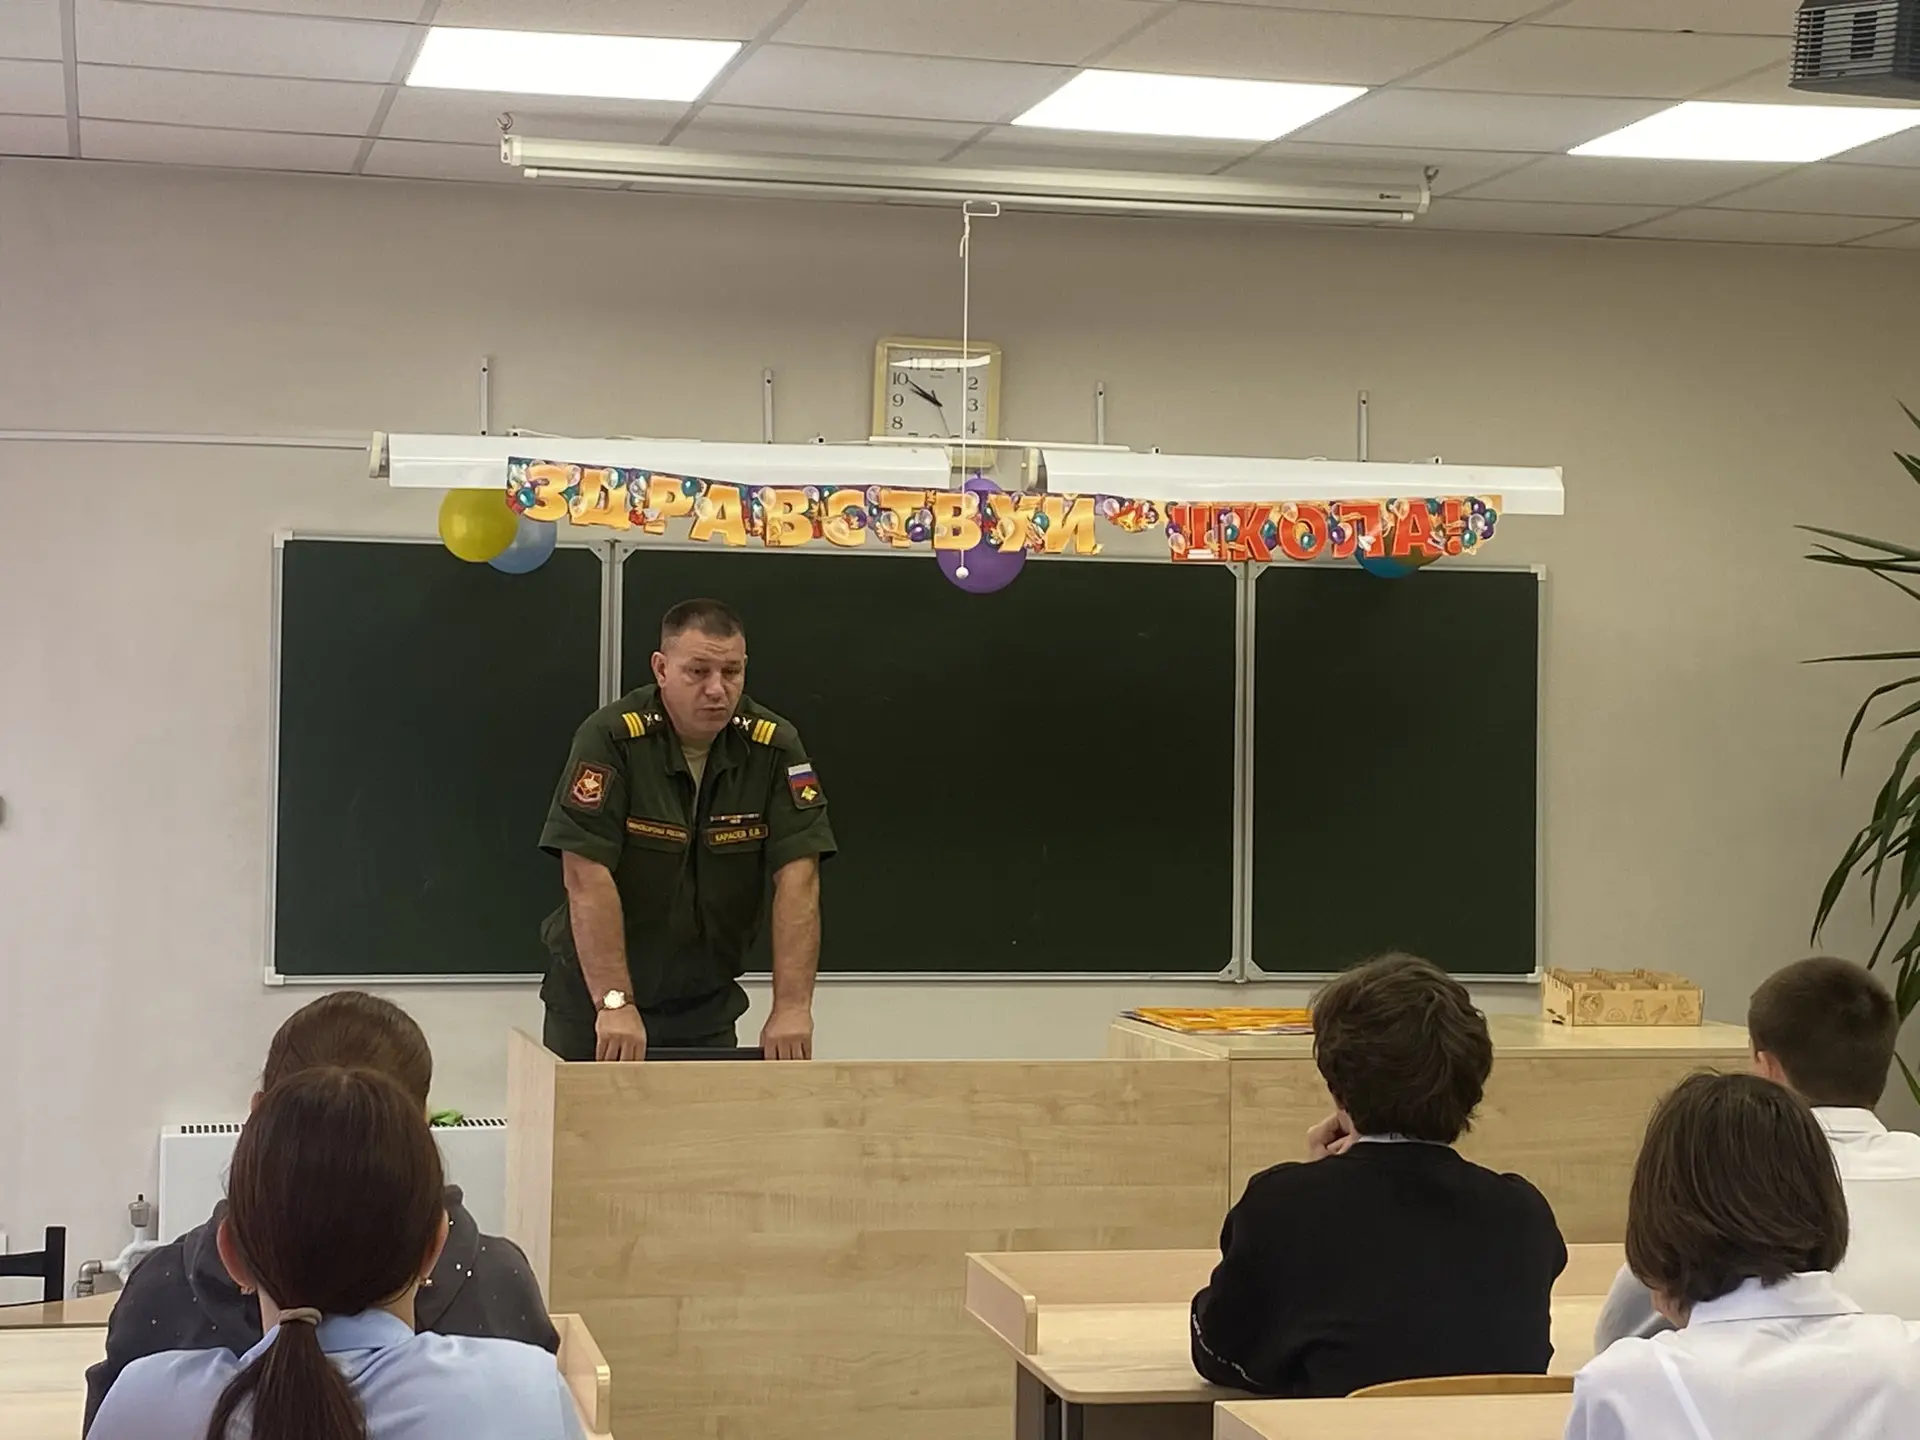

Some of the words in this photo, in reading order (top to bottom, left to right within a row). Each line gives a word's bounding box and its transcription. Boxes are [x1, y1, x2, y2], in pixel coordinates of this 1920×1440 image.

[892, 371, 909, 385] 10
[967, 376, 979, 390] 2
[892, 393, 904, 407] 9
[967, 398, 979, 412] 3
[891, 415, 904, 430] 8
[967, 421, 979, 434] 4
[1171, 500, 1463, 563] ШКОЛА!
